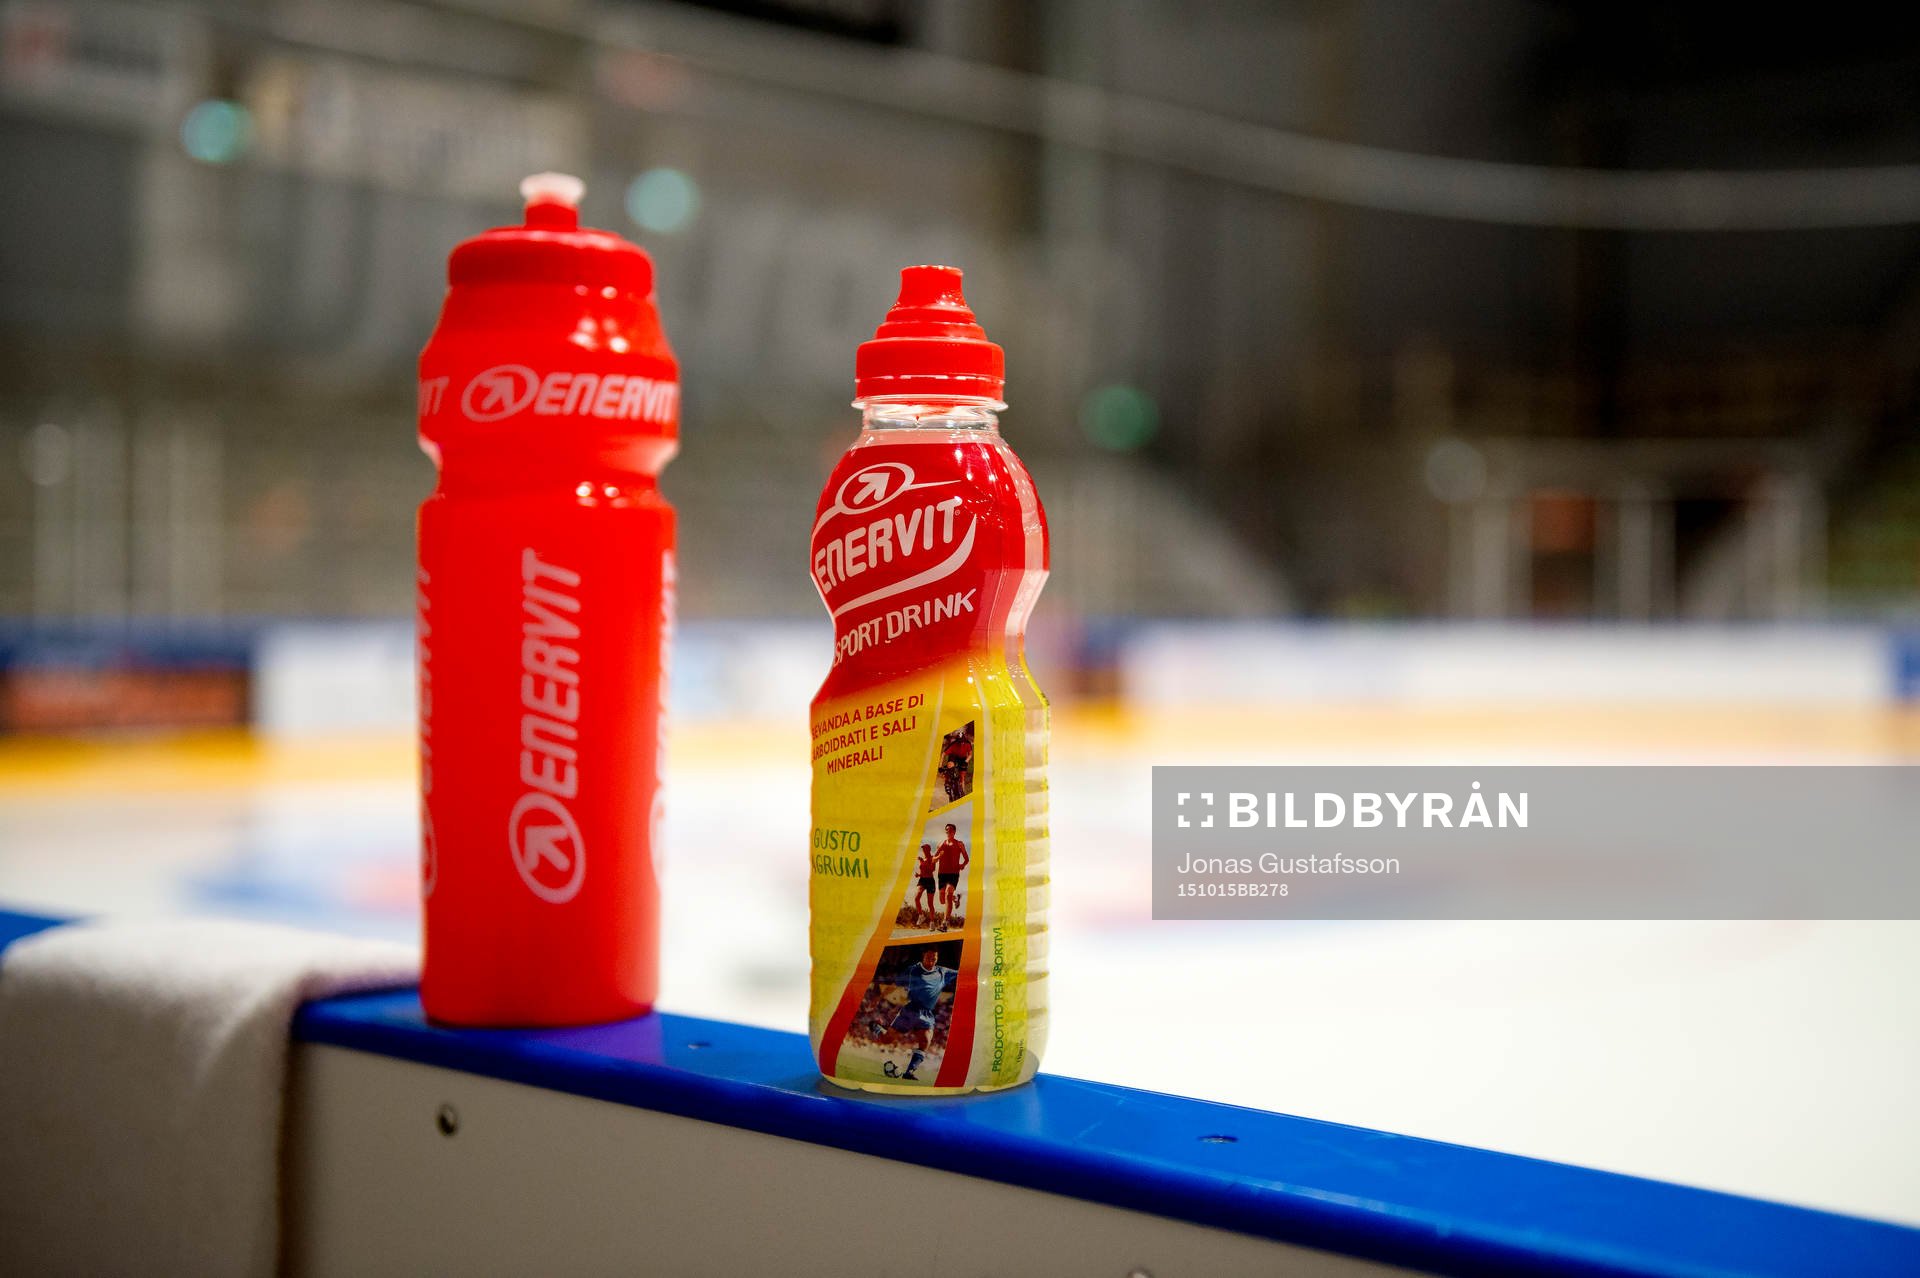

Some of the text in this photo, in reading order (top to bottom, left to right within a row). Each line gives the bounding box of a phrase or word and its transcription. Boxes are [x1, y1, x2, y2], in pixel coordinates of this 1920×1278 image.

[533, 372, 679, 425] ENERVIT
[814, 496, 963, 595] ENERVIT
[833, 588, 977, 668] SPORT DRINK
[520, 547, 581, 799] ENERVIT
[852, 708, 862, 724] A
[865, 698, 904, 721] BASE
[908, 693, 924, 709] DI
[870, 725, 879, 740] E
[882, 715, 916, 737] SALI
[827, 745, 883, 775] MINERALI
[814, 827, 861, 852] GUSTO
[992, 927, 1004, 1073] PRODOTTO PER SPORTIVI
